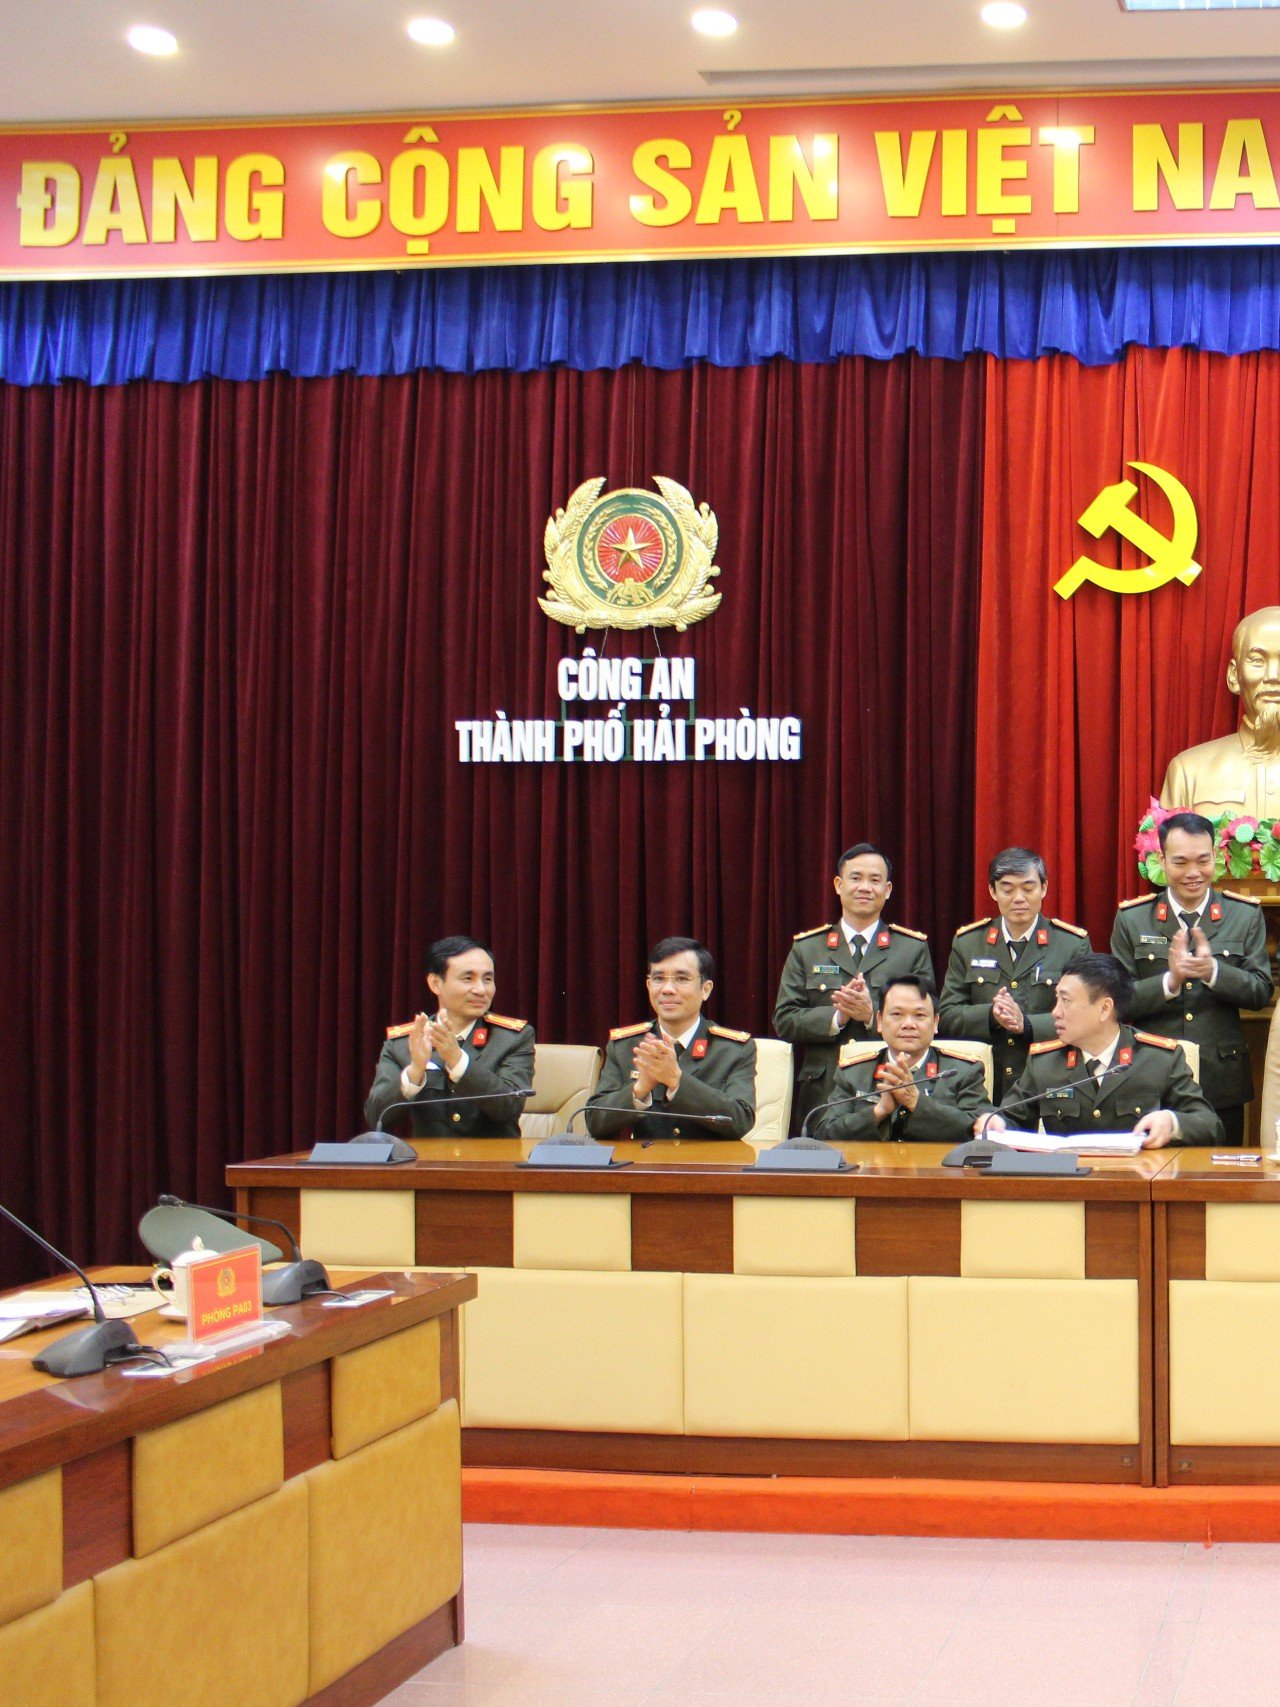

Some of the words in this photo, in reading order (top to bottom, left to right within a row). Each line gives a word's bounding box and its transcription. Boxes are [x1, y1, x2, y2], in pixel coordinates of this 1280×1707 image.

[15, 131, 285, 247] ĐẢNG
[322, 126, 595, 255] CỘNG
[629, 109, 840, 228] SẢN
[874, 105, 1096, 234] VIỆT
[557, 647, 643, 701] CÔNG
[649, 656, 695, 700] AN
[455, 710, 555, 763] THÀNH
[563, 702, 627, 762] PHỐ
[633, 703, 686, 762] HẢI
[694, 707, 802, 761] PHÒNG
[233, 1299, 252, 1317] PA03
